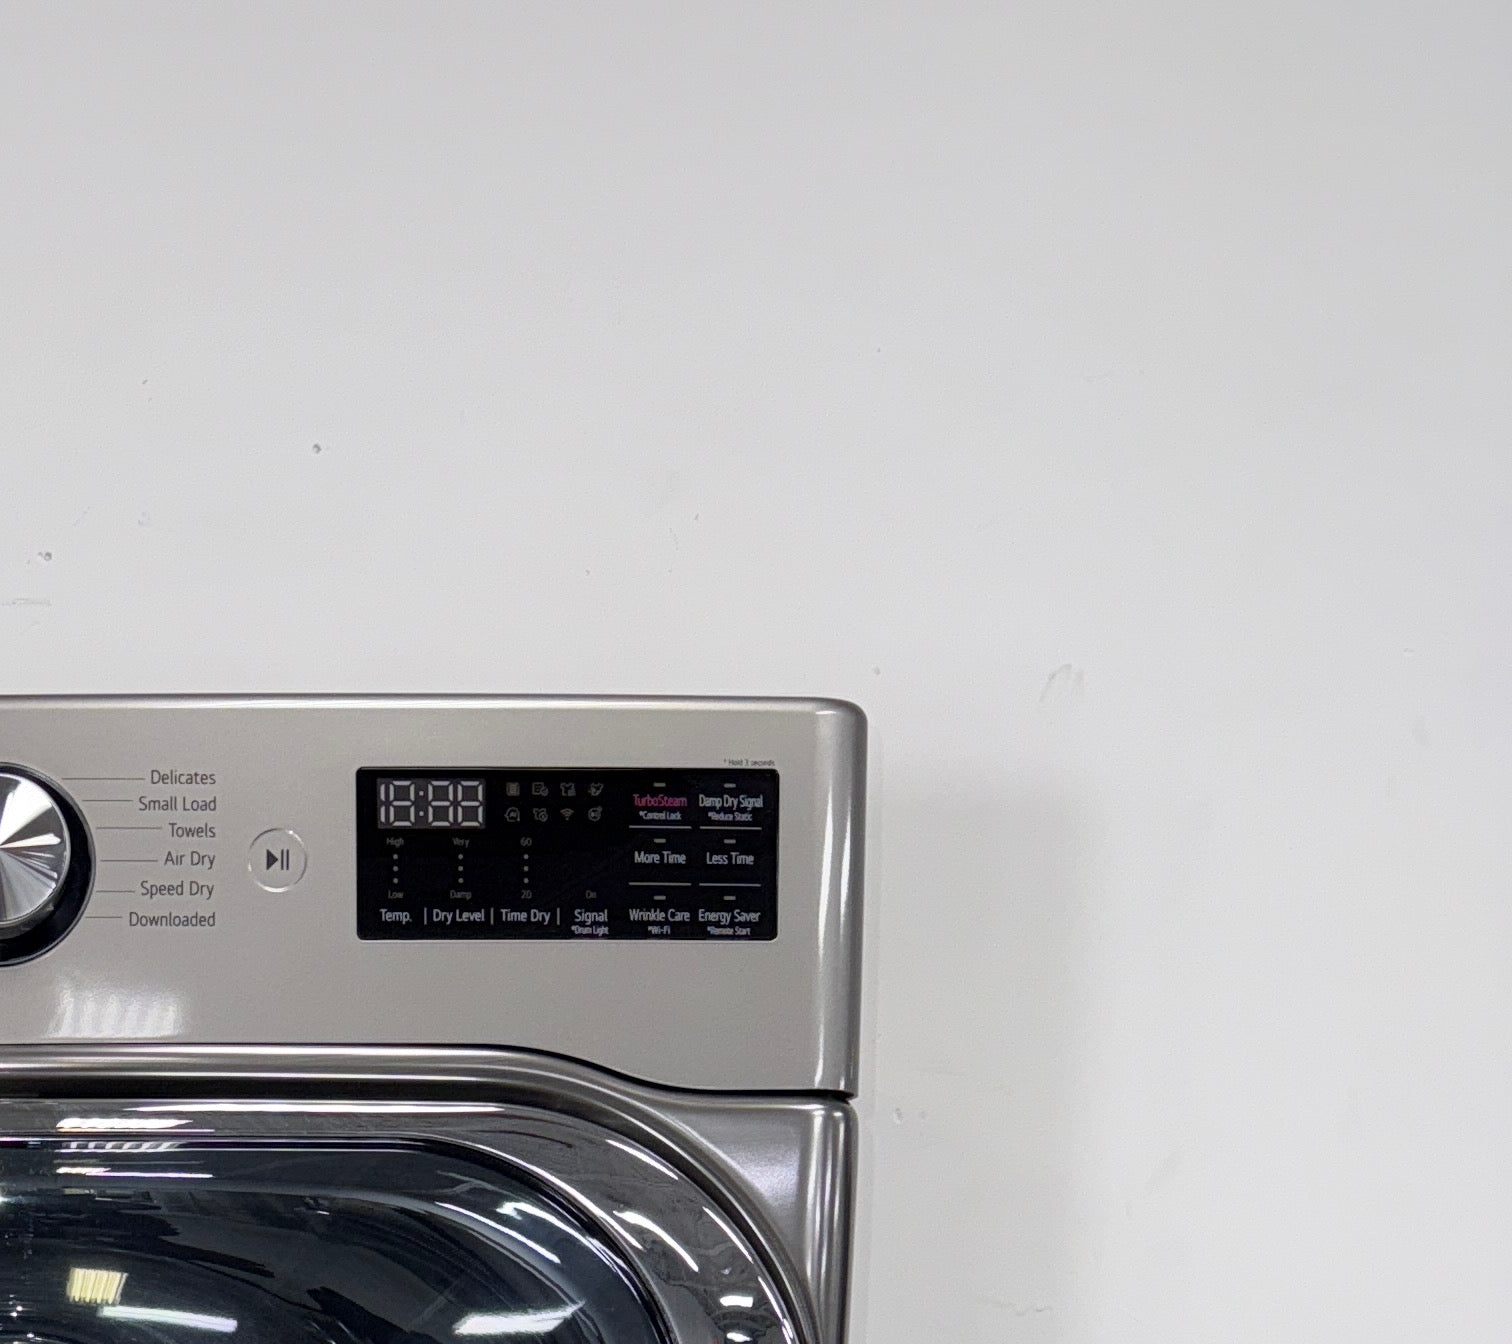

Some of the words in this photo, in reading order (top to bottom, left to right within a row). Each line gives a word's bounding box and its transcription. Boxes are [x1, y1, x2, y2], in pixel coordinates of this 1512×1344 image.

[151, 770, 216, 785] Delicates
[138, 796, 178, 812] Small
[182, 796, 217, 811] Load
[633, 793, 688, 807] TurboSteam
[698, 793, 723, 810] Damp
[723, 794, 738, 810] Dry
[739, 794, 764, 811] Signal
[168, 822, 216, 838] Towels
[520, 836, 533, 847] 60
[164, 851, 184, 866] Air
[190, 851, 216, 870] Dry
[634, 850, 660, 864] More
[662, 850, 687, 865] Time
[706, 851, 728, 865] Less
[730, 851, 755, 865] Time
[140, 880, 184, 898] Speed
[189, 880, 215, 900] Dry
[521, 889, 533, 899] 20
[129, 911, 216, 928] Downloaded
[379, 908, 412, 925] Temp.
[432, 908, 453, 925] Dry
[455, 908, 486, 922] Level
[500, 908, 528, 922] Time
[530, 908, 551, 925] Dry
[574, 908, 608, 925] Signal
[629, 908, 666, 922] Wrinkle
[667, 908, 691, 922] Care
[698, 908, 732, 925] Energy
[733, 909, 761, 923] Saver
